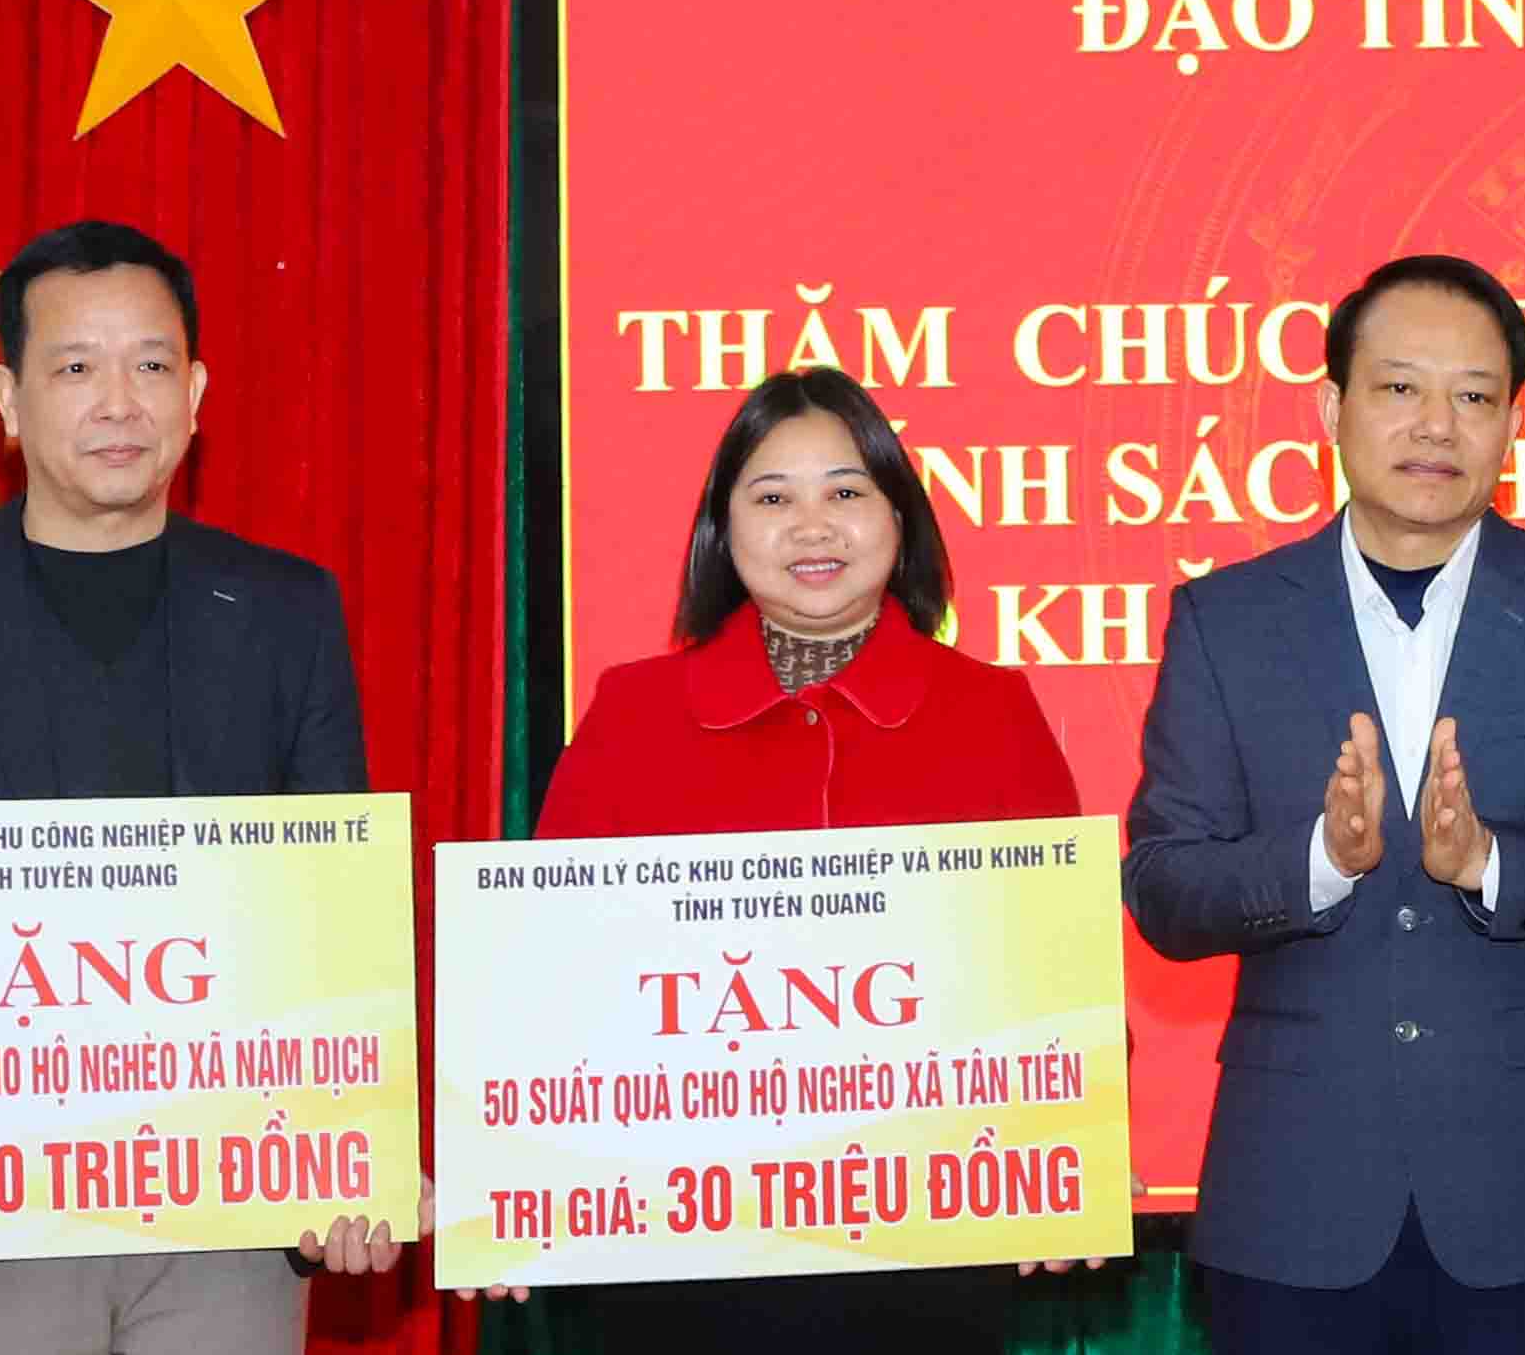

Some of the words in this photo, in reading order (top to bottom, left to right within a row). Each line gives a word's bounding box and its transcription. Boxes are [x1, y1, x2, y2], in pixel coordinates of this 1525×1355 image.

[618, 283, 956, 391] THĂM
[1014, 276, 1327, 385] CHÚC
[20, 861, 93, 889] TUYÊN
[101, 863, 178, 890] QUANG
[478, 867, 524, 889] BAN
[532, 861, 594, 889] QUẢN
[603, 861, 628, 885] LÝ
[636, 860, 681, 884] CÁC
[689, 860, 734, 882] KHU
[742, 853, 804, 880] CÔNG
[811, 849, 894, 879] NGHIỆP
[902, 846, 931, 873] VÀ
[938, 848, 982, 871] KHU
[991, 845, 1045, 868] KINH
[1052, 835, 1078, 865] TẾ
[732, 891, 803, 919] TUYÊN
[811, 891, 886, 917] QUANG
[640, 950, 923, 1052] TẶNG
[32, 1035, 70, 1106] HỘ
[80, 1033, 177, 1093] NGHÈO
[188, 1030, 226, 1089] XÃ
[235, 1029, 302, 1099] NẬM
[313, 1035, 379, 1096] DỊCH
[484, 1079, 518, 1126] 50
[530, 1059, 604, 1125] SUẤT
[613, 1062, 671, 1127] QUÀ
[681, 1070, 739, 1119] CHO
[750, 1059, 787, 1126] HỘ
[798, 1053, 894, 1113] NGHÈO
[905, 1049, 943, 1107] XÃ
[952, 1047, 1008, 1105] TÂN
[1018, 1037, 1082, 1101] TIẾN
[44, 1124, 200, 1224] TRIỆU
[219, 1109, 370, 1203] ĐỒNG
[490, 1188, 552, 1249] TRỊ
[568, 1174, 647, 1239] GIÁ:
[667, 1165, 733, 1233] 30
[752, 1143, 908, 1240] TRIỆU
[928, 1126, 1080, 1219] ĐỒNG
